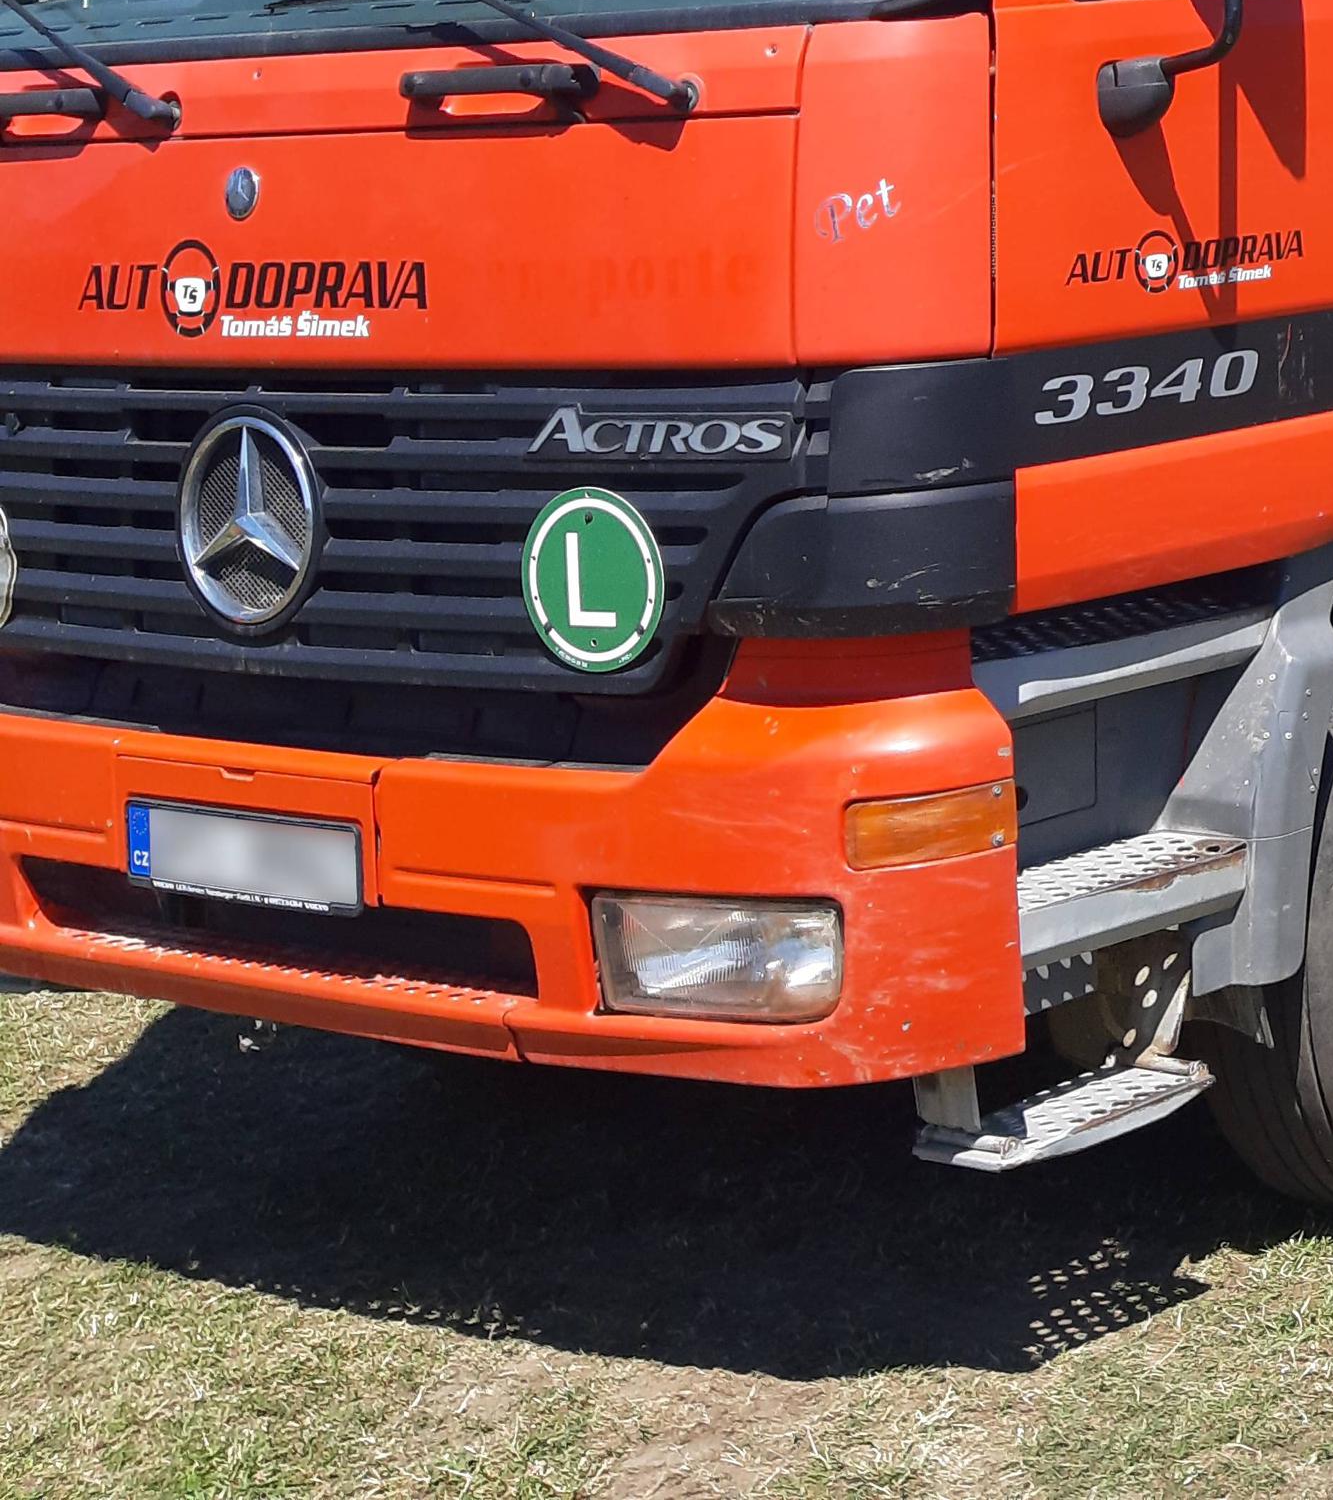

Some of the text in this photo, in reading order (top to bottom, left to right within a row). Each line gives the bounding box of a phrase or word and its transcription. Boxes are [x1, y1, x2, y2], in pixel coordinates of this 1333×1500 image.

[220, 314, 293, 338] Tomáš
[1034, 349, 1260, 426] 3340
[564, 531, 618, 628] L
[133, 849, 150, 868] CZ
